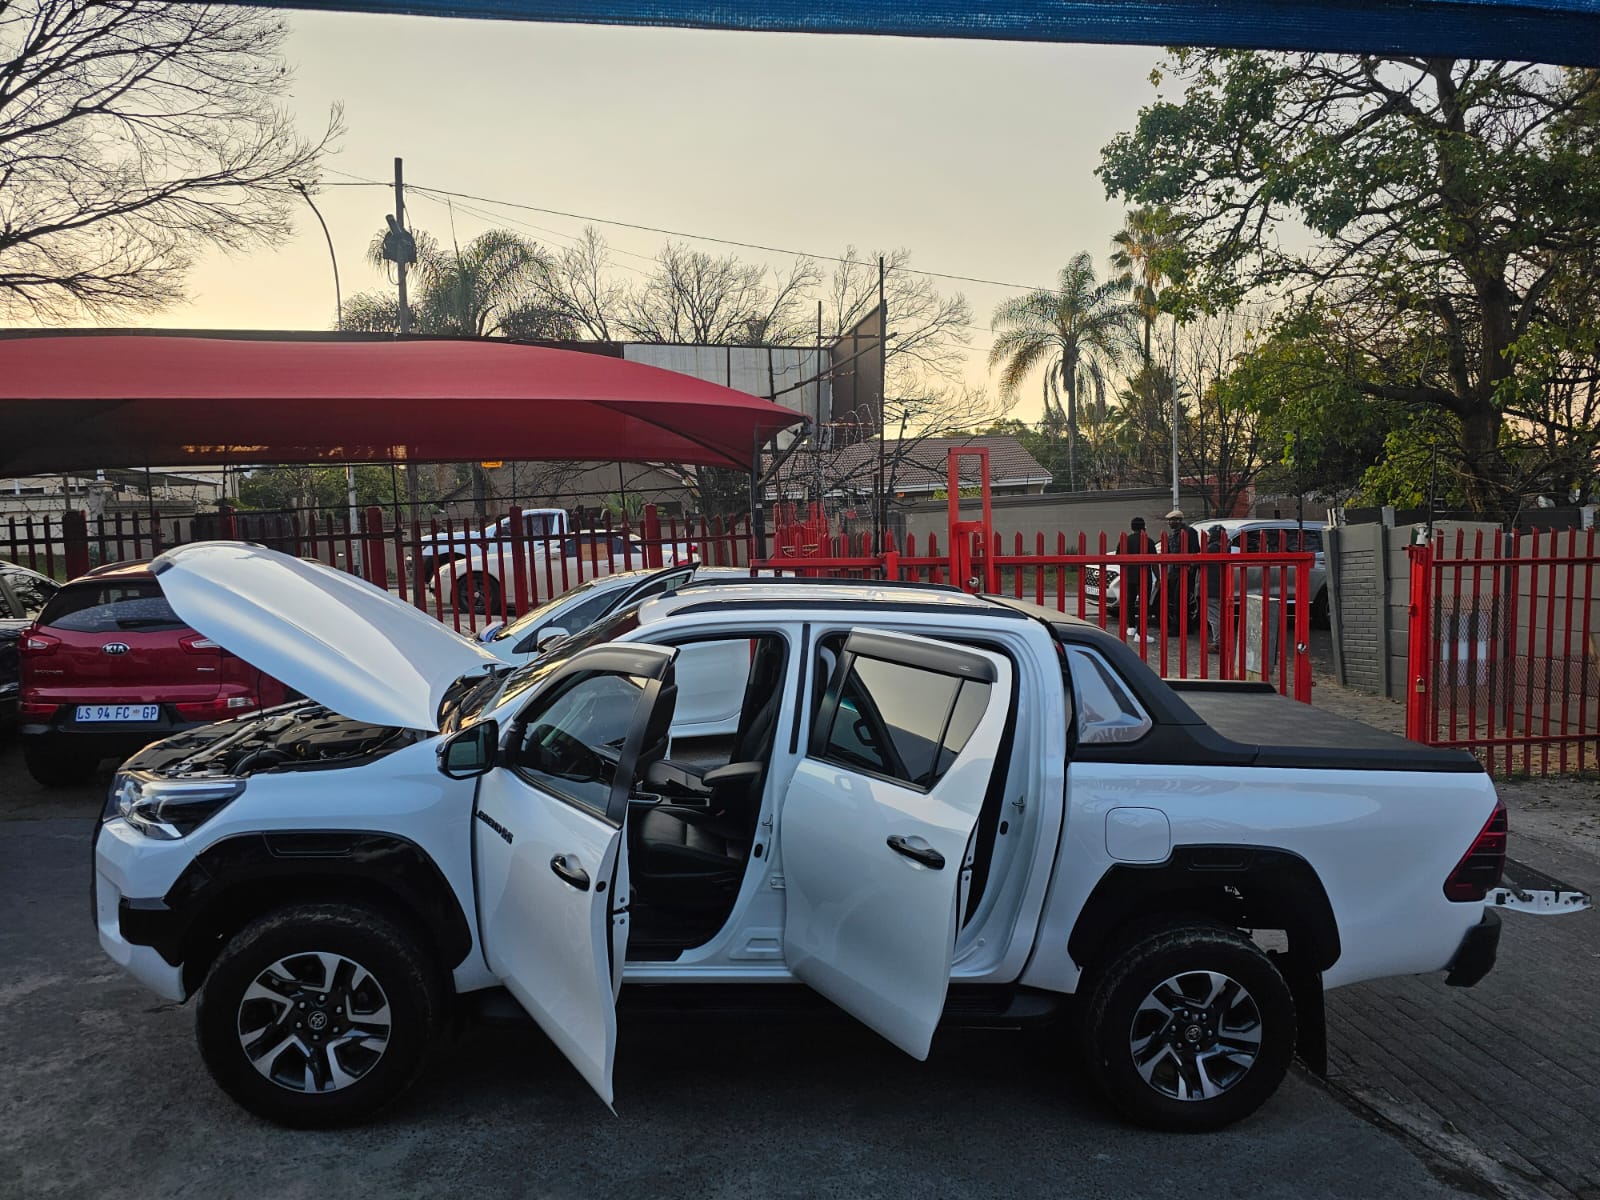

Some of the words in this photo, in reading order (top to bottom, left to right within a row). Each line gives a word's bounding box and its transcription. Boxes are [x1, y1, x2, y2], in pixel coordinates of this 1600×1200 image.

[106, 645, 125, 653] KIA
[77, 707, 91, 720] LS
[97, 706, 110, 719] 94
[115, 706, 130, 719] FC
[142, 706, 157, 719] GP
